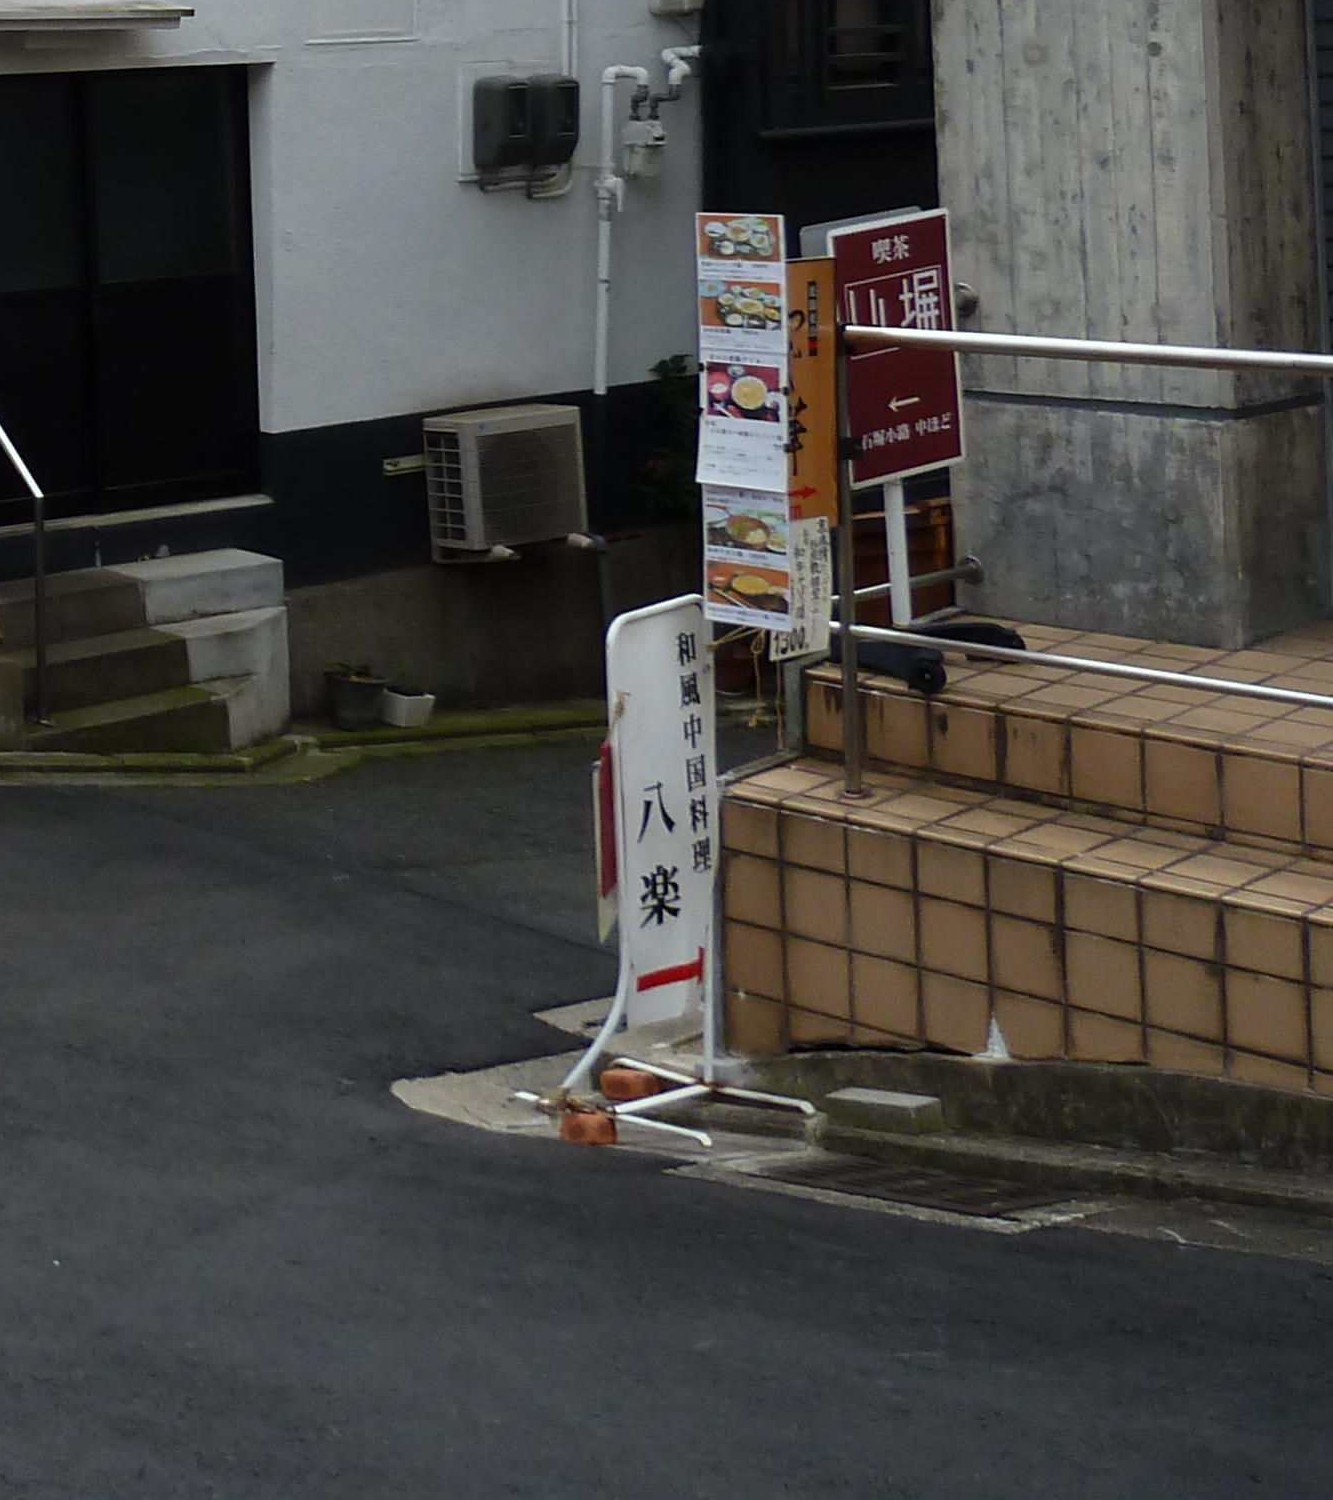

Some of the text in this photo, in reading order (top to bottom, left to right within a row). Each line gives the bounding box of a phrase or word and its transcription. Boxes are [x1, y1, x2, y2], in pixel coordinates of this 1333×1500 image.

[871, 234, 911, 264] 喫茶
[915, 412, 952, 436] 中ほど
[676, 632, 713, 873] 和風中国料理
[637, 780, 682, 928] 八楽
